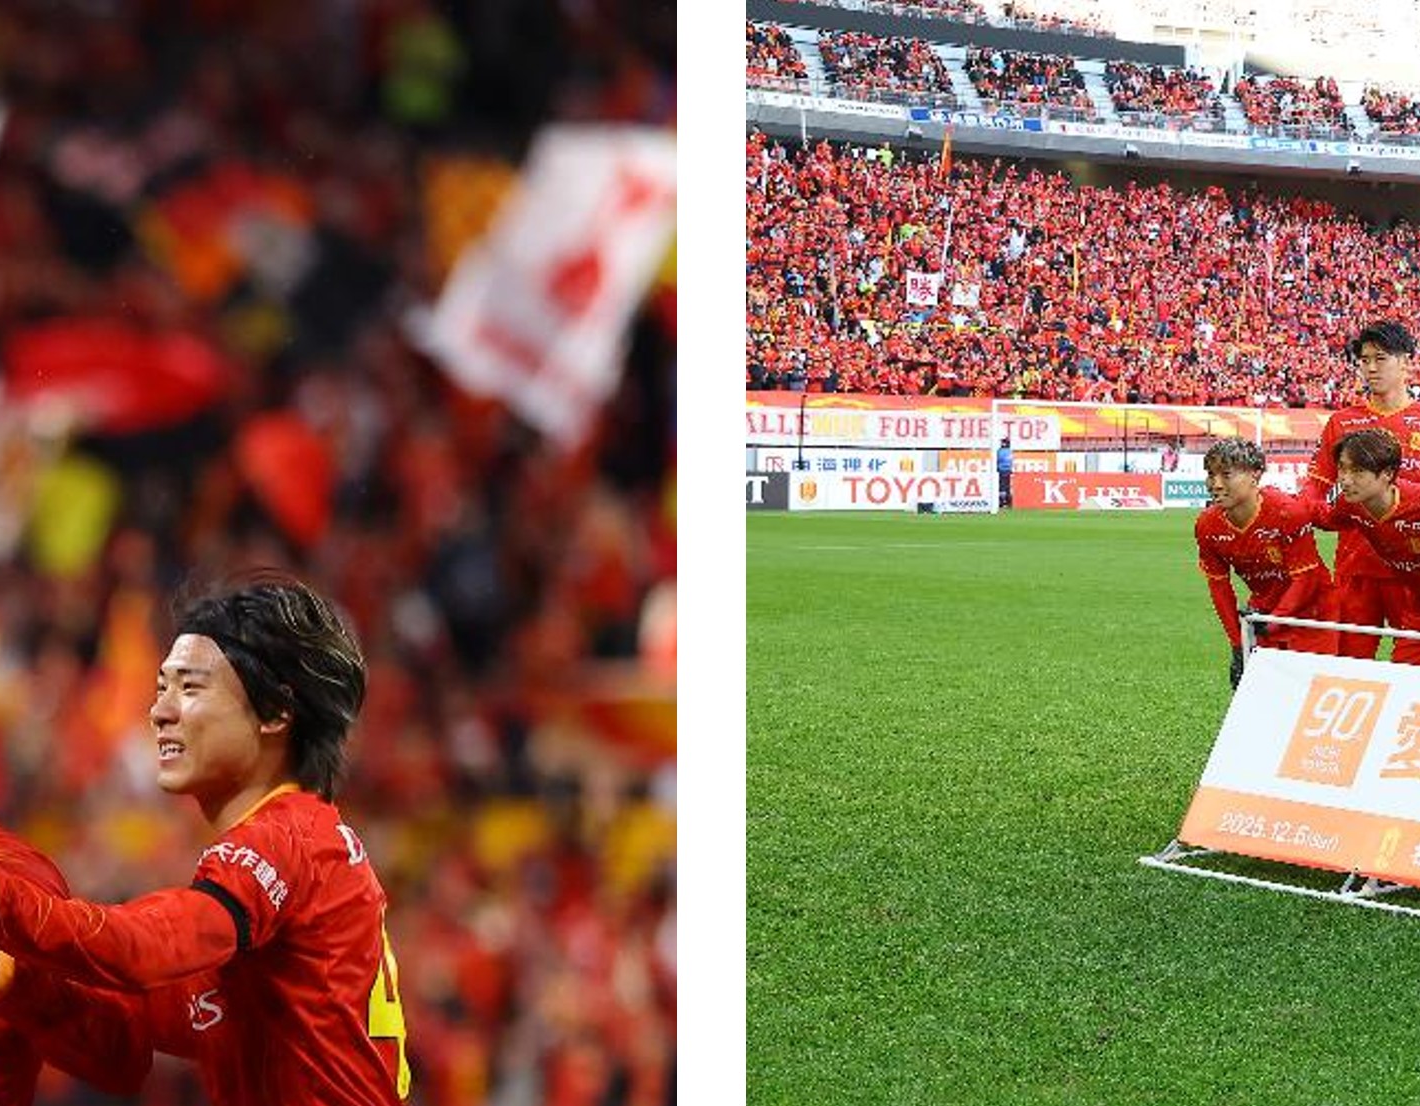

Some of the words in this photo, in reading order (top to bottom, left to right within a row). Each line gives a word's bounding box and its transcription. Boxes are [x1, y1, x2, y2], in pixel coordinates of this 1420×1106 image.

[879, 416, 928, 438] FOR
[941, 417, 991, 439] THE
[1003, 419, 1049, 441] TOP
[842, 476, 982, 503] TOYOTA
[1303, 687, 1376, 741] 90
